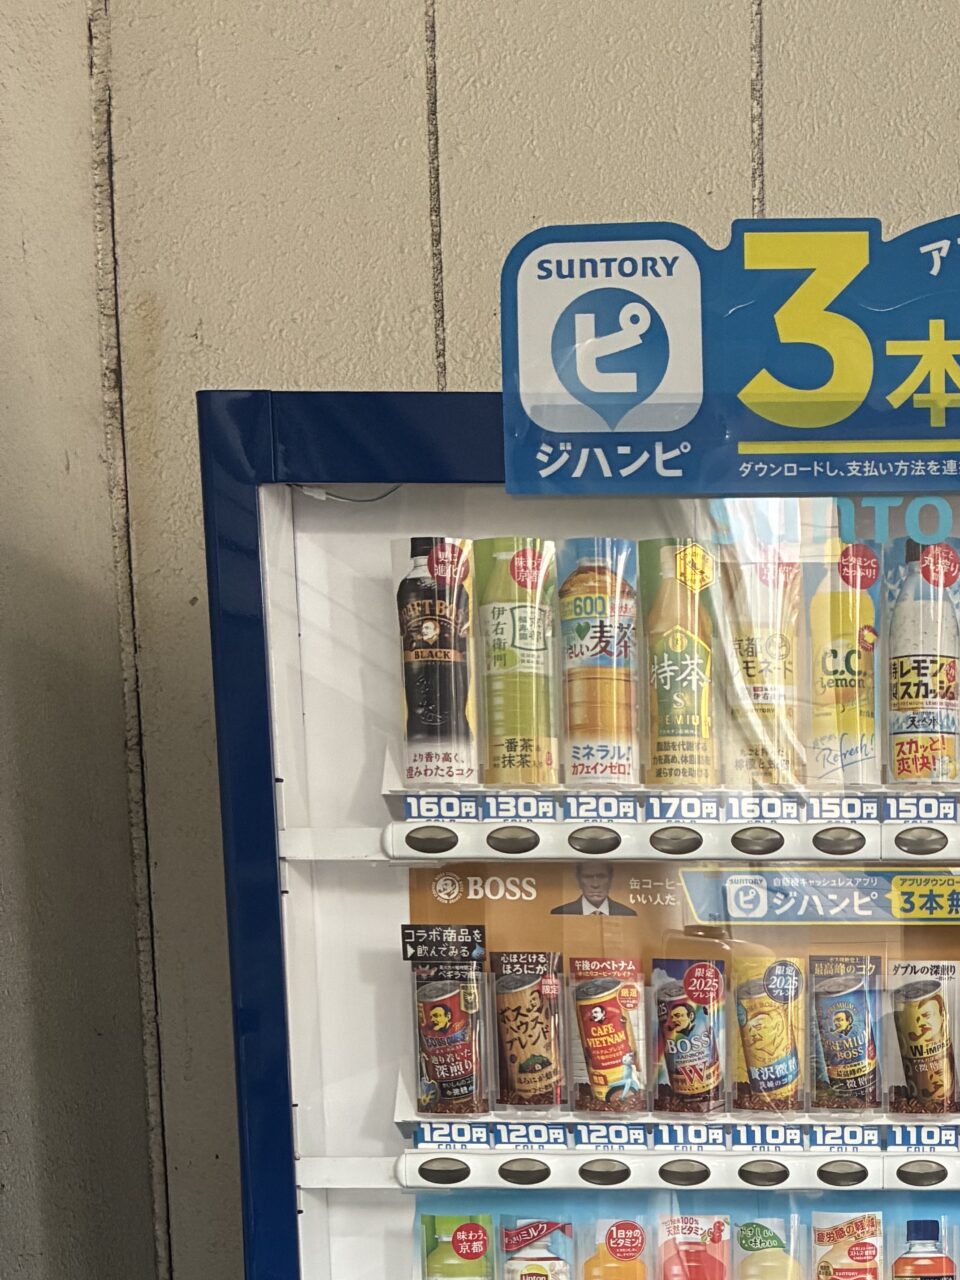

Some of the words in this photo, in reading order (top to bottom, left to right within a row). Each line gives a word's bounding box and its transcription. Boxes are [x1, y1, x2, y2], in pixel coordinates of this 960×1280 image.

[535, 253, 681, 282] SUNTORY
[574, 302, 654, 394] ピ
[535, 441, 692, 480] ジハンピ
[573, 596, 606, 616] 600
[413, 649, 451, 661] BLACK
[494, 738, 534, 753] 一番茶
[571, 744, 632, 761] ミネラル!
[571, 763, 632, 777] カフェインゼロ!
[407, 797, 476, 818] 160円
[486, 797, 554, 818] 130円
[566, 797, 635, 818] 120円
[649, 797, 716, 818] 170円
[728, 797, 798, 818] 160円
[809, 797, 878, 818] 150円
[886, 797, 955, 818] 150円
[467, 876, 537, 900] BOSS
[772, 890, 879, 916] ジハンピ
[404, 927, 483, 942] コラボ商品を
[416, 944, 470, 957] 飲んでみる
[575, 959, 637, 972] 午後のベトナム
[892, 963, 957, 977] ダブルの深煎り
[591, 1023, 616, 1038] CAFE
[666, 1030, 711, 1055] BOSS
[420, 1124, 487, 1144] 120円
[496, 1124, 565, 1144] 120円
[576, 1125, 645, 1145] 120円
[658, 1125, 720, 1145] 110円
[736, 1125, 800, 1145] 110円
[812, 1125, 878, 1145] 120円
[891, 1126, 957, 1146] 110円
[609, 1237, 642, 1248] ビタミン!
